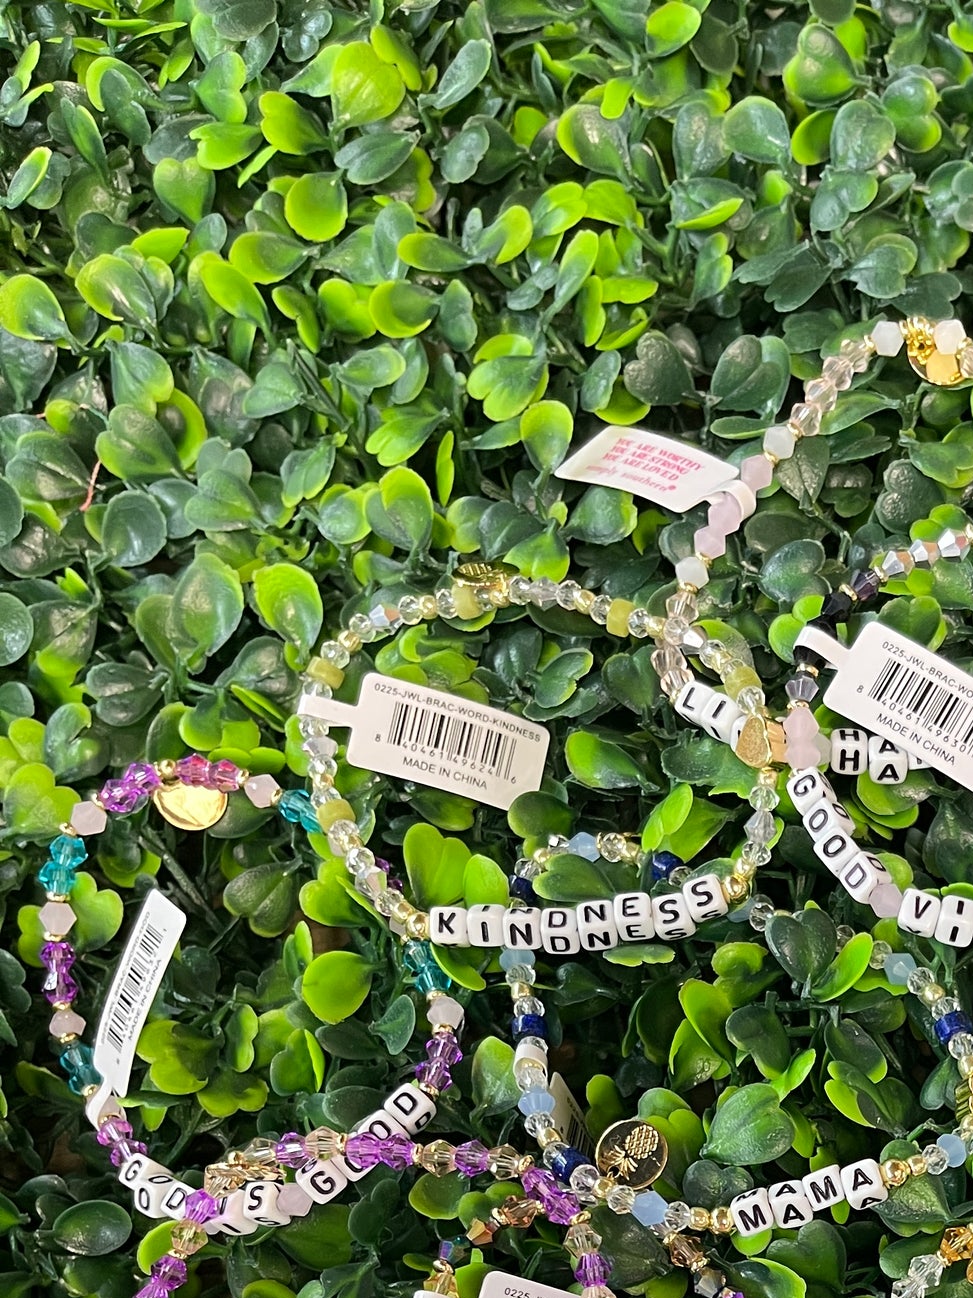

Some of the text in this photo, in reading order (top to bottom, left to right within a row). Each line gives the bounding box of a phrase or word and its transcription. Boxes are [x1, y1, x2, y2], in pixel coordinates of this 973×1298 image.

[642, 463, 680, 480] LOVED
[650, 456, 689, 475] STRONG
[659, 449, 703, 472] WORTHY
[374, 683, 541, 742] 0225-JWL-BRAC-WORD-KINDNESS
[857, 685, 864, 693] 8
[882, 698, 920, 725] 40461
[928, 725, 966, 753] 49630
[375, 734, 381, 742] 8
[402, 742, 444, 760] 40461
[453, 757, 493, 775] 49624
[876, 713, 956, 766] MADE IN CHINA
[403, 757, 487, 790] MADE IN CHINA
[793, 771, 887, 889] GOOD
[439, 880, 723, 953] KINDNESS
[128, 959, 161, 1040] MADE IN CHINA
[125, 1159, 186, 1212] GOD
[736, 1168, 883, 1232] MAMA
